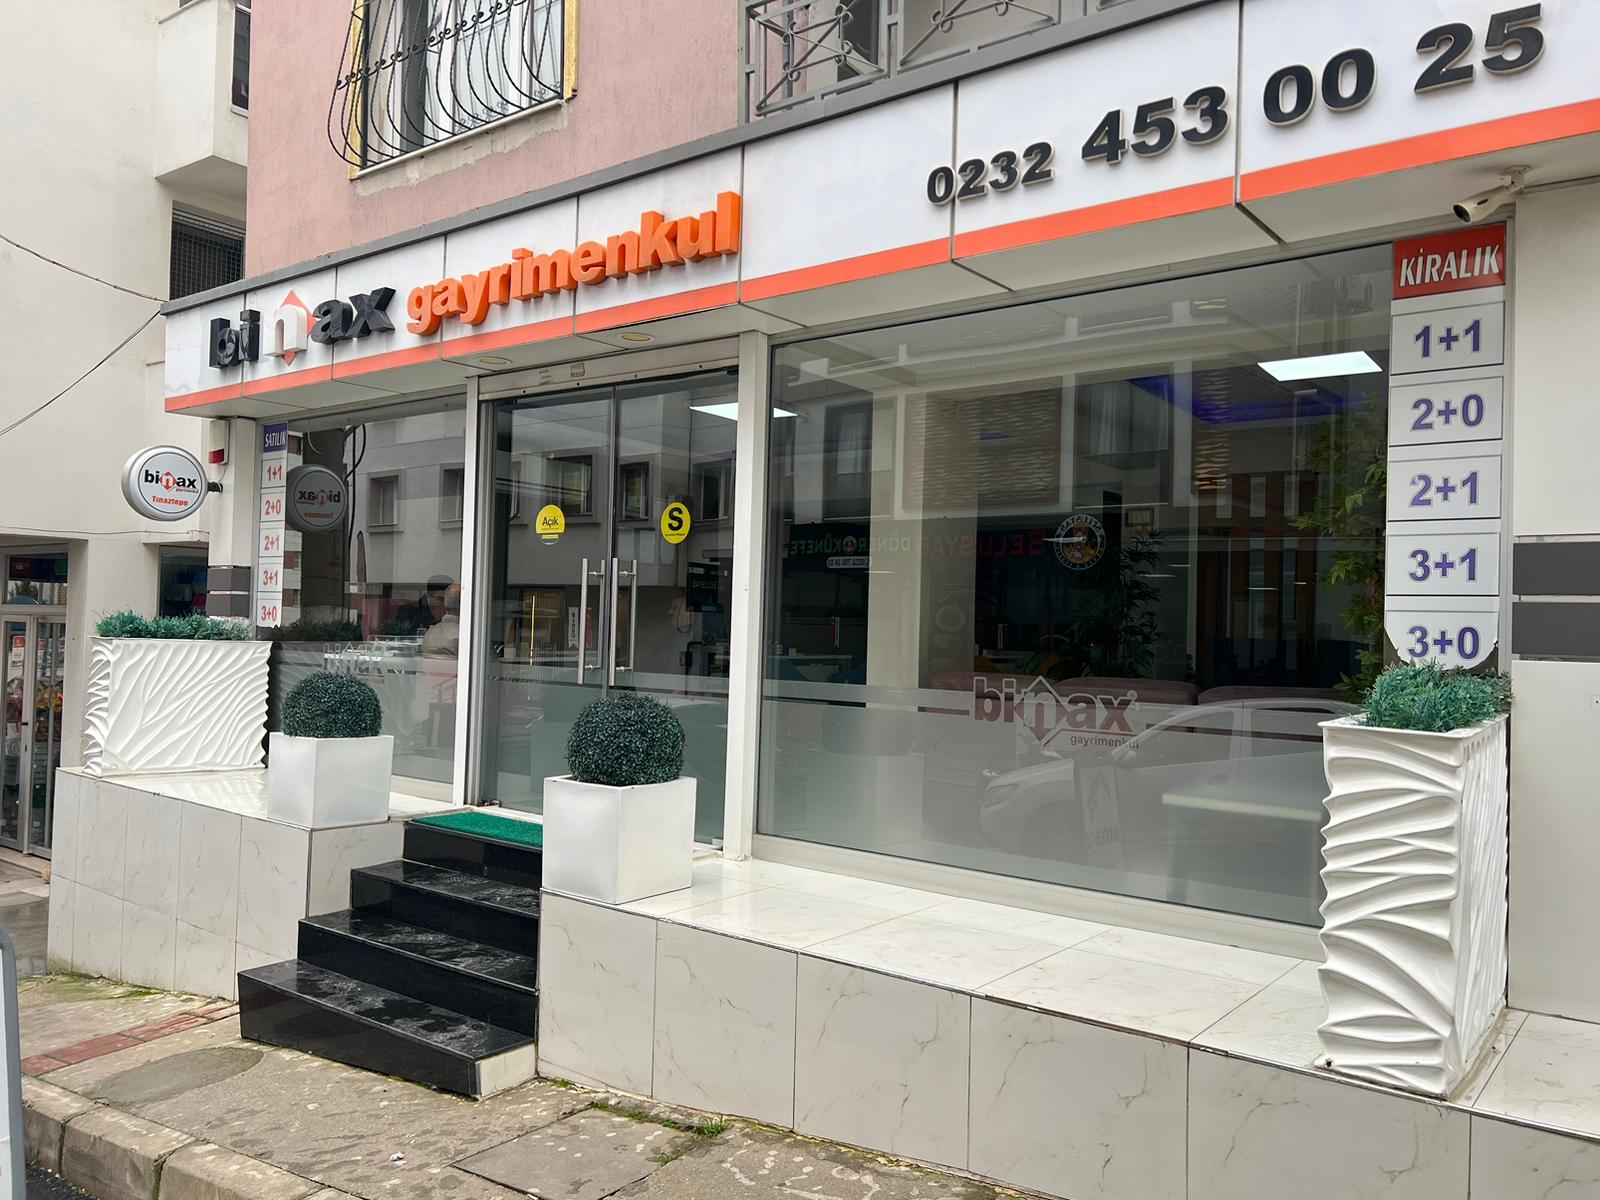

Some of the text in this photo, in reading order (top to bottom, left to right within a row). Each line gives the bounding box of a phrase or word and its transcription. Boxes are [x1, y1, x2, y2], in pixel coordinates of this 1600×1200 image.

[926, 3, 1546, 205] 0232 453 00 25
[208, 190, 742, 368] binax gayrimenkul
[1400, 244, 1500, 288] KİRALIK
[1415, 319, 1481, 358] 1+1
[1411, 394, 1484, 431] 2+0
[144, 469, 197, 489] binax
[267, 464, 282, 482] 1+1
[1409, 471, 1479, 506] 2+1
[265, 499, 281, 516] 2+0
[667, 506, 684, 532] S
[264, 535, 280, 551] 2+1
[263, 569, 278, 586] 3+1
[1409, 548, 1478, 582] 3+1
[261, 606, 277, 621] 3+0
[1408, 625, 1480, 660] 3+0
[973, 677, 1138, 733] binax
